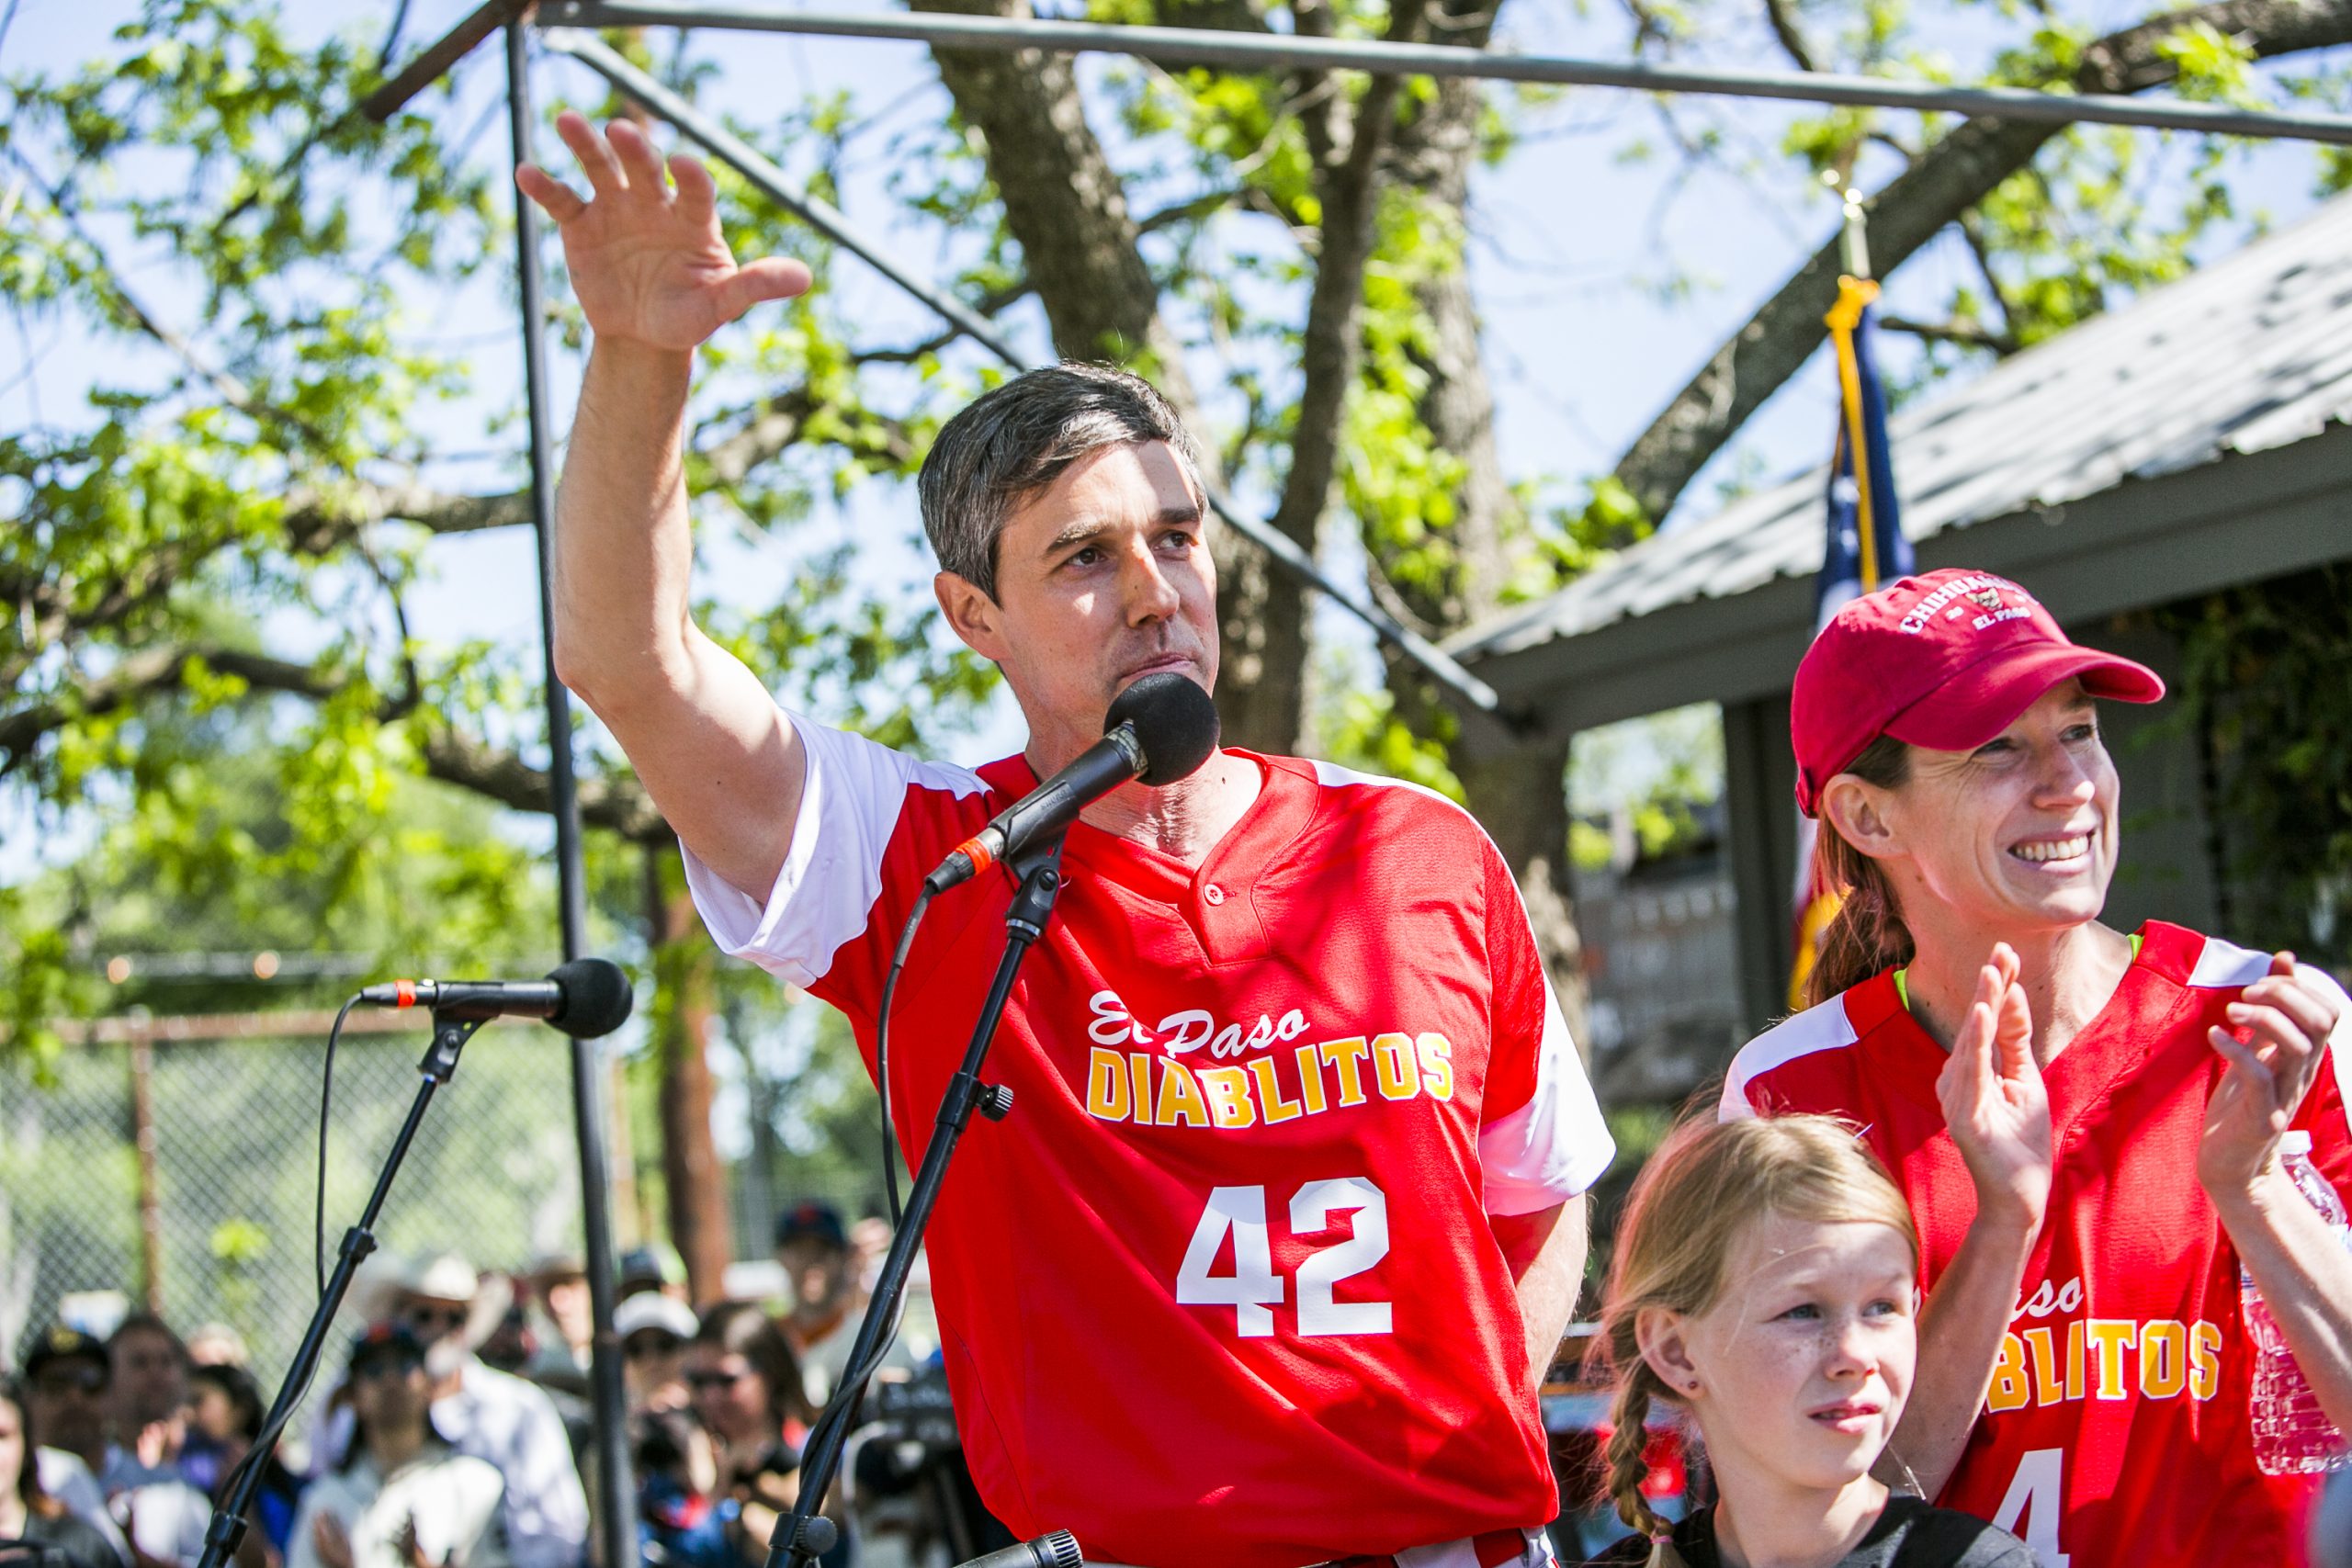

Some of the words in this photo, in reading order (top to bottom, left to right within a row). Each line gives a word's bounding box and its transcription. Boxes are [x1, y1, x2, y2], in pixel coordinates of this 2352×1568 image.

[1899, 575, 2041, 635] CHIHUA
[1972, 615, 1996, 631] EL
[1158, 1009, 1310, 1059] Paso
[1086, 1032, 1453, 1129] DIABLITOS
[1176, 1176, 1393, 1337] 42
[2009, 1276, 2085, 1324] so
[1984, 1318, 2223, 1414] BLITOS
[1989, 1448, 2071, 1568] 4
